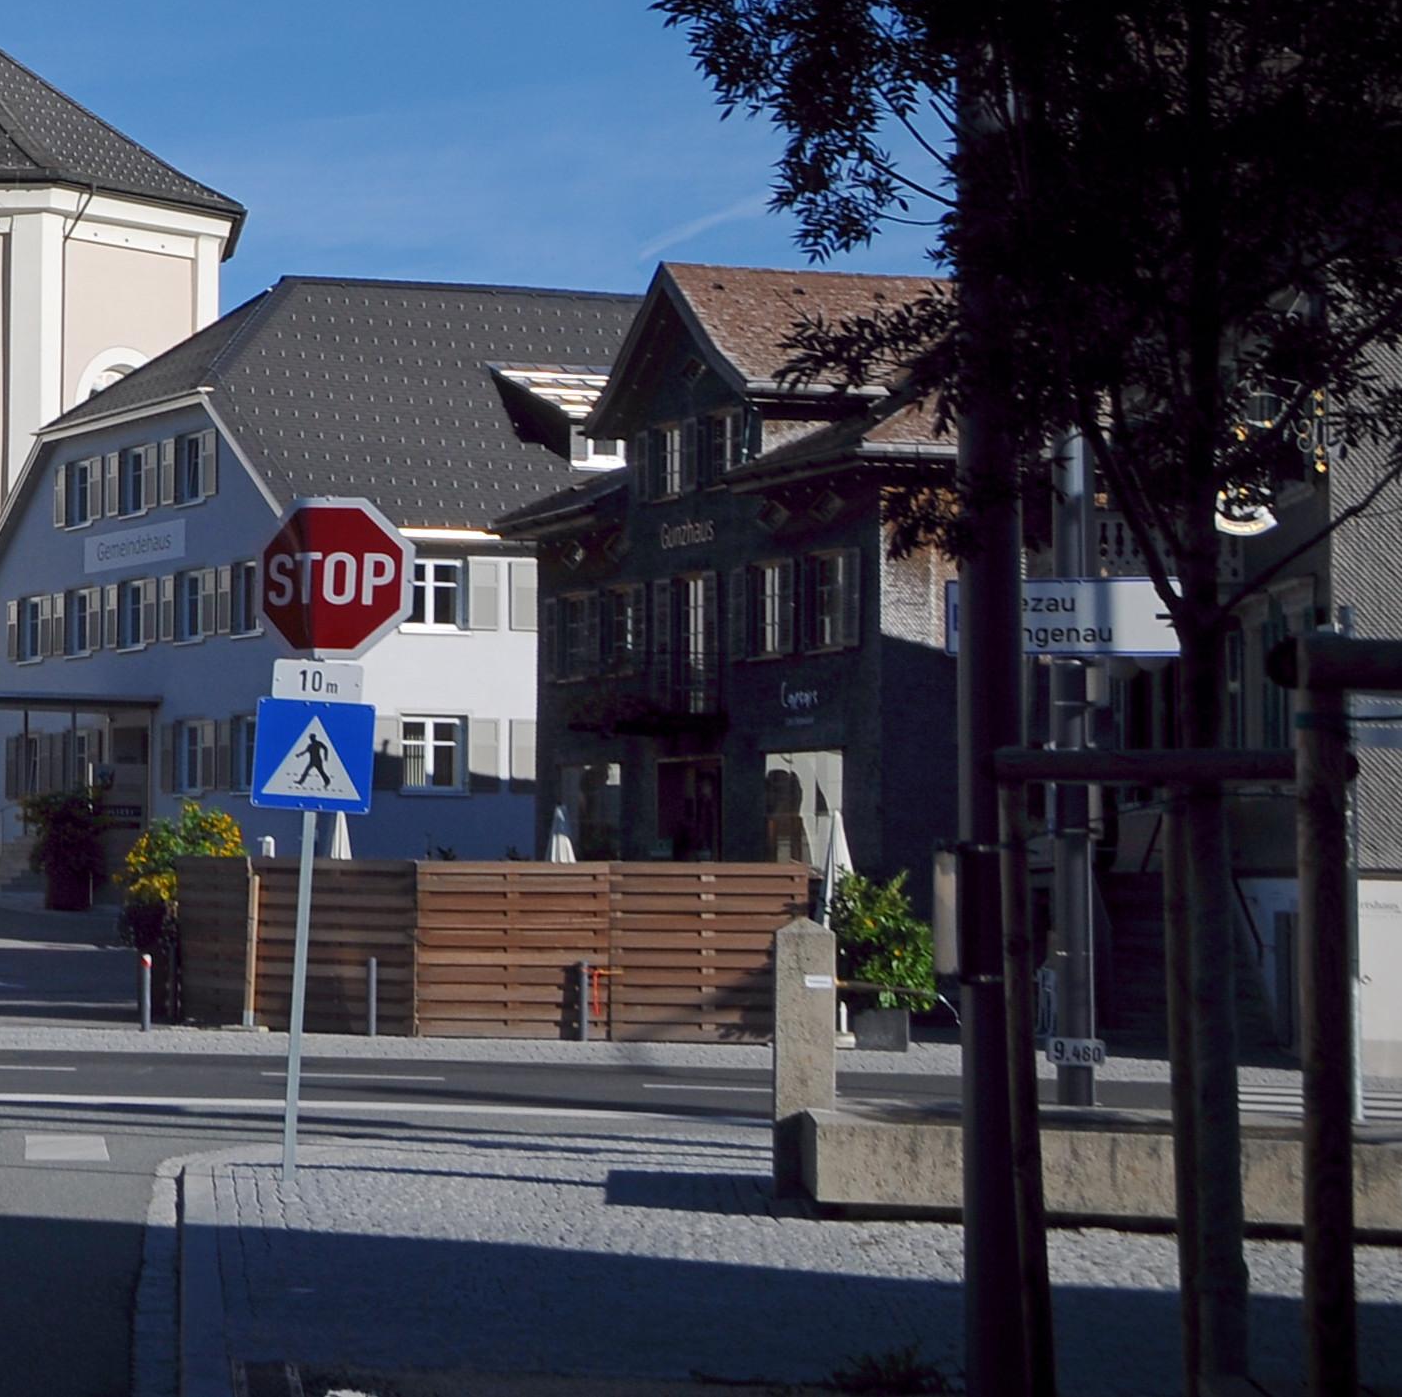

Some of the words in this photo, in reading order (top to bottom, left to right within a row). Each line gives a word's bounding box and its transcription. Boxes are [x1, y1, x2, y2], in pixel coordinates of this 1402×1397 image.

[97, 532, 172, 562] Gemeindehaus
[267, 551, 396, 607] STOP
[1020, 596, 1076, 613] ezau
[1020, 626, 1113, 648] ngenau
[299, 669, 323, 693] 10
[325, 681, 339, 694] m
